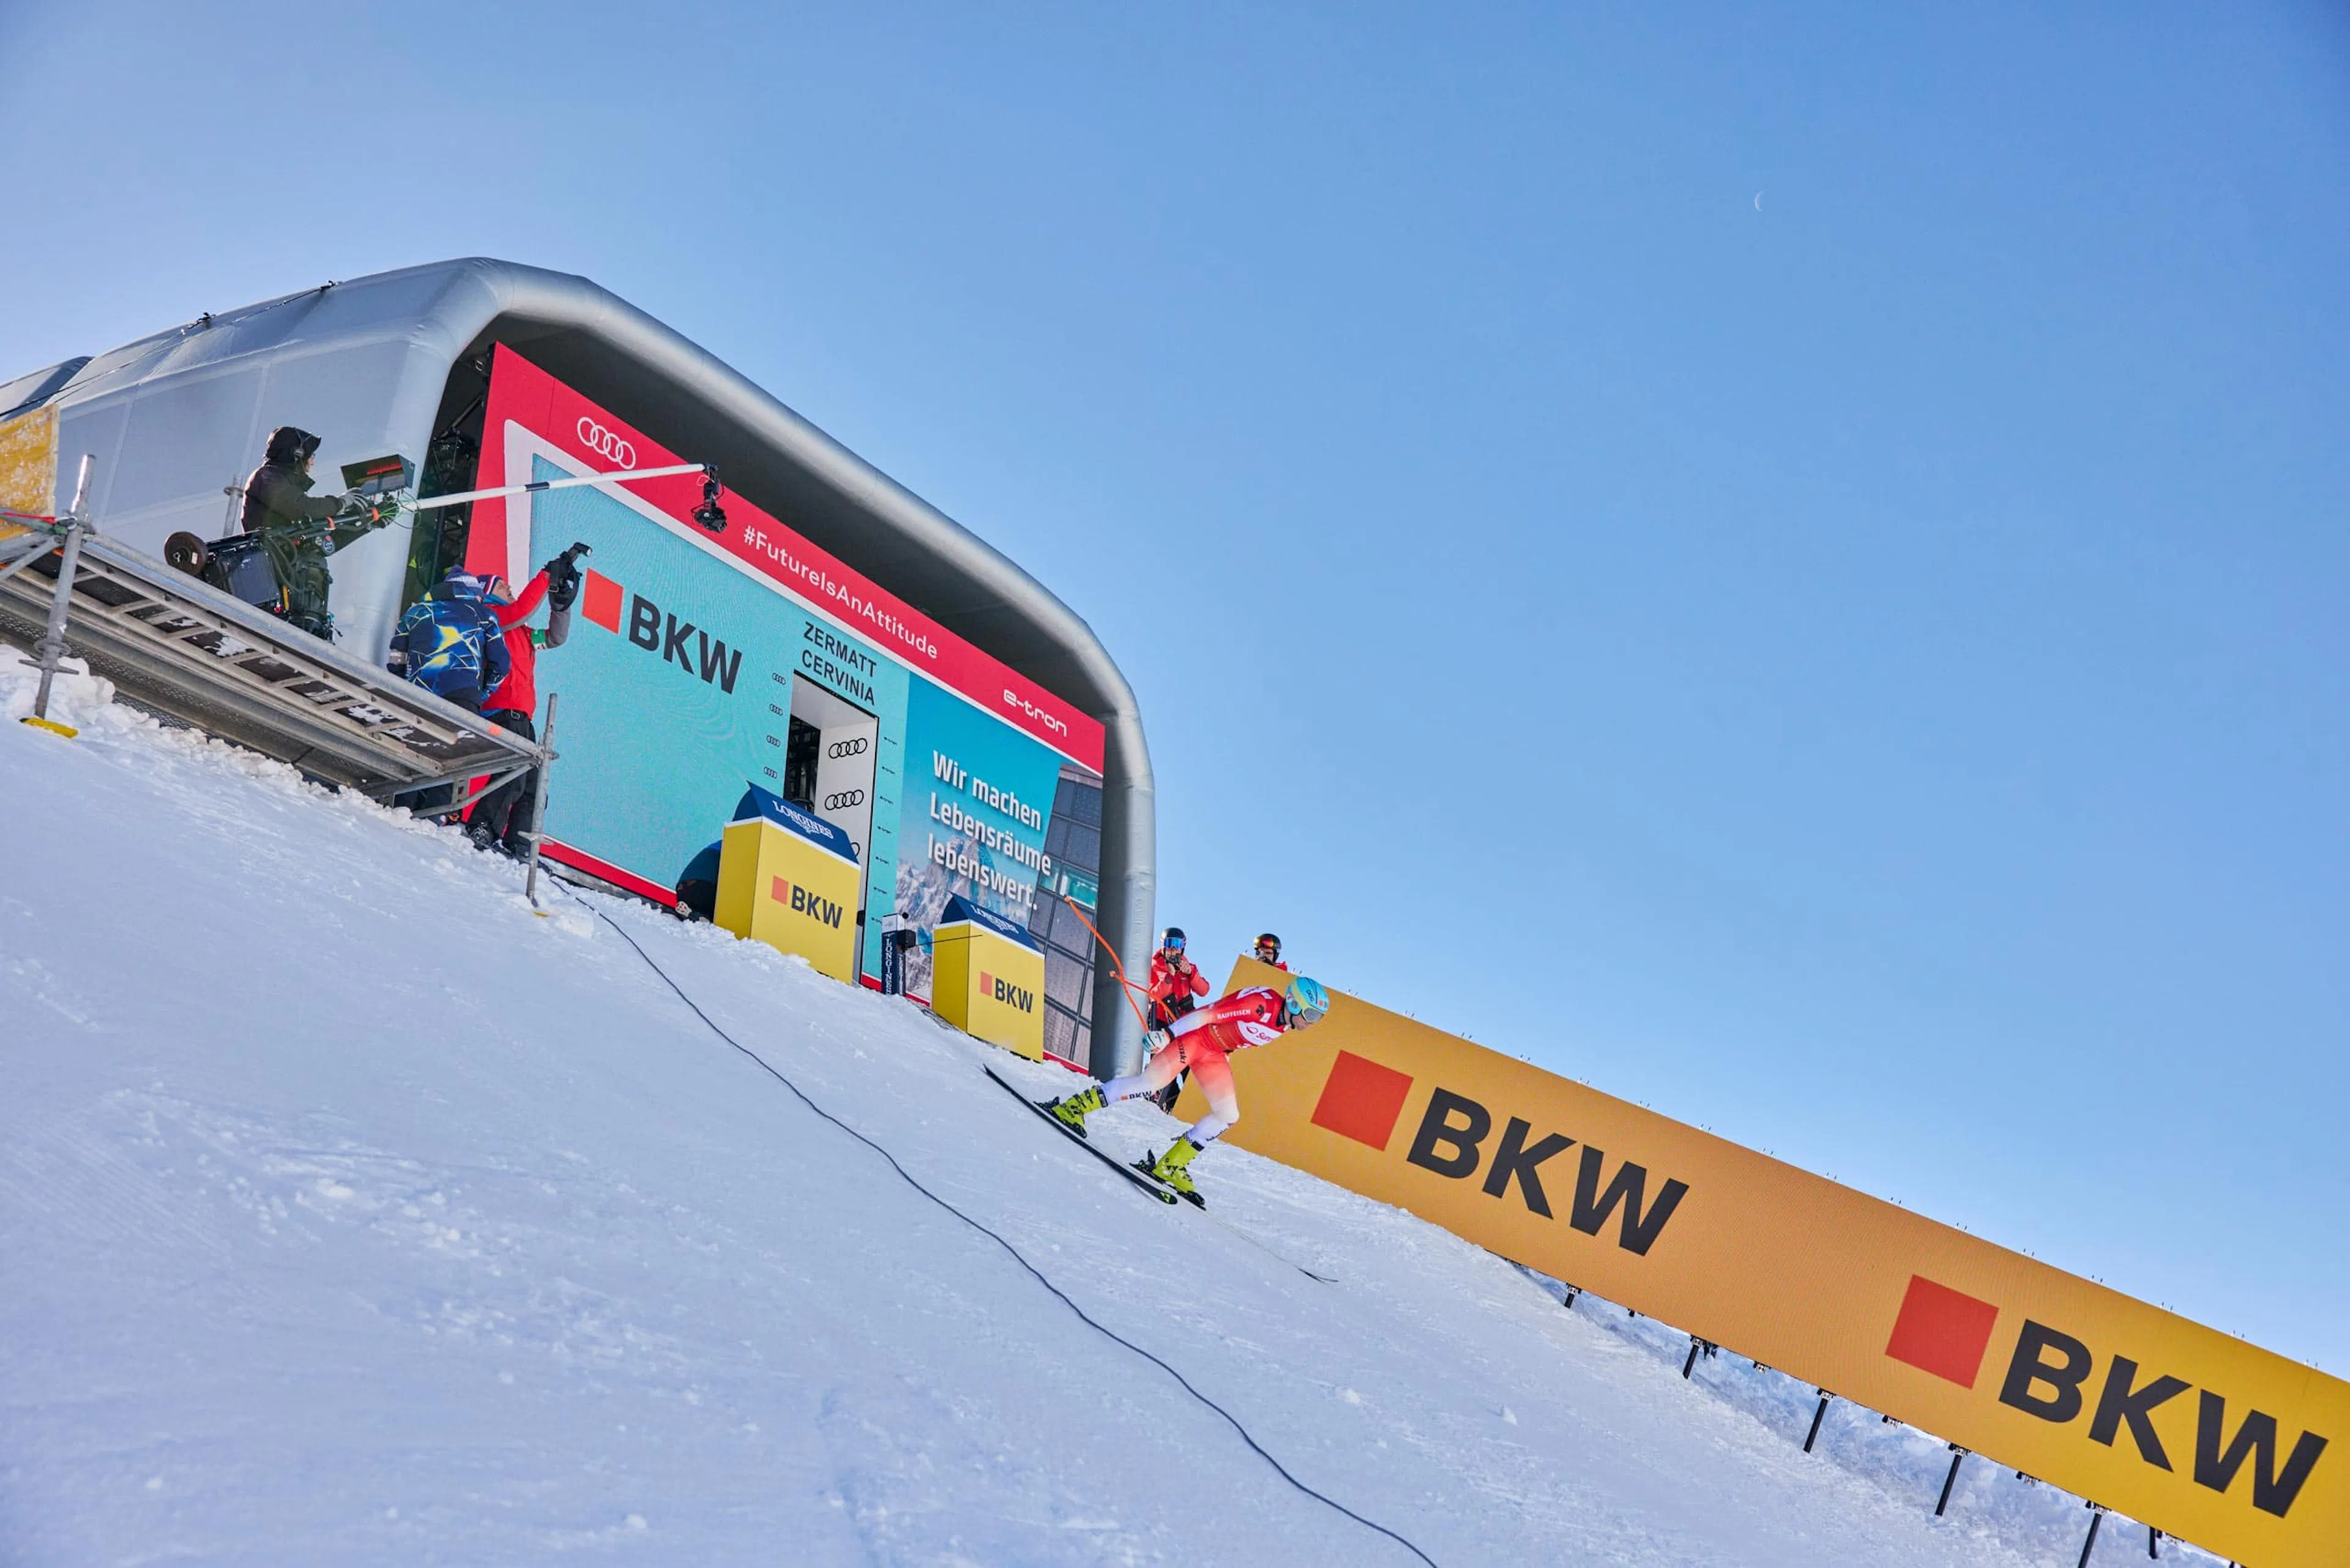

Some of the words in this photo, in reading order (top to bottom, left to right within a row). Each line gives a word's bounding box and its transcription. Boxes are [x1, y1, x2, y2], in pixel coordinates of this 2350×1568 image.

[744, 525, 938, 659] #FutureIsAnAttitude
[629, 594, 742, 695] BKW
[802, 649, 876, 706] CERVINIA
[803, 621, 877, 678] ZERMATT
[1004, 689, 1067, 737] e-tron
[933, 750, 967, 789] Wir
[972, 777, 1042, 831] machen
[928, 834, 1038, 911] lebenswert.
[930, 793, 1051, 876] Lebensräume
[791, 885, 843, 929] BKW
[995, 978, 1033, 1013] BKW
[1217, 1009, 1251, 1020] RAIFFEISEN
[1407, 1087, 1690, 1256] BKW
[1999, 1318, 2330, 1518] BKW
